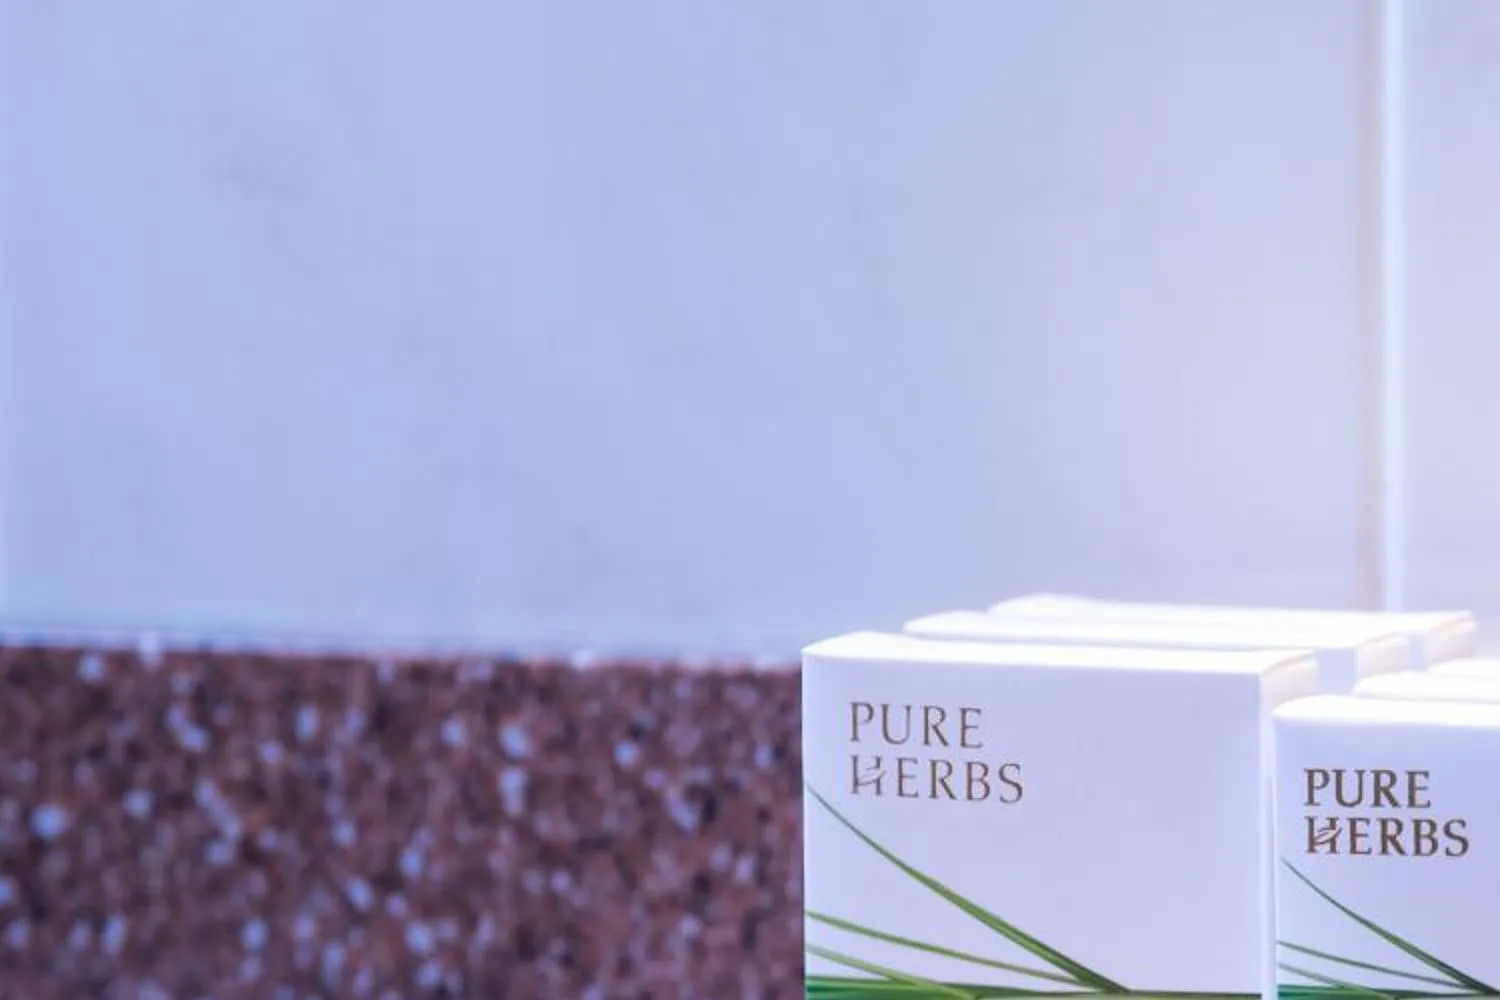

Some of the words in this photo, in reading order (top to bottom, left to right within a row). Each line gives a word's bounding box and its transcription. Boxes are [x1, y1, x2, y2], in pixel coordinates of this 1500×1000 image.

[849, 701, 983, 749] PURE
[850, 754, 1024, 804] HERBS
[1303, 767, 1431, 809] PURE
[1304, 815, 1470, 858] HERBS
